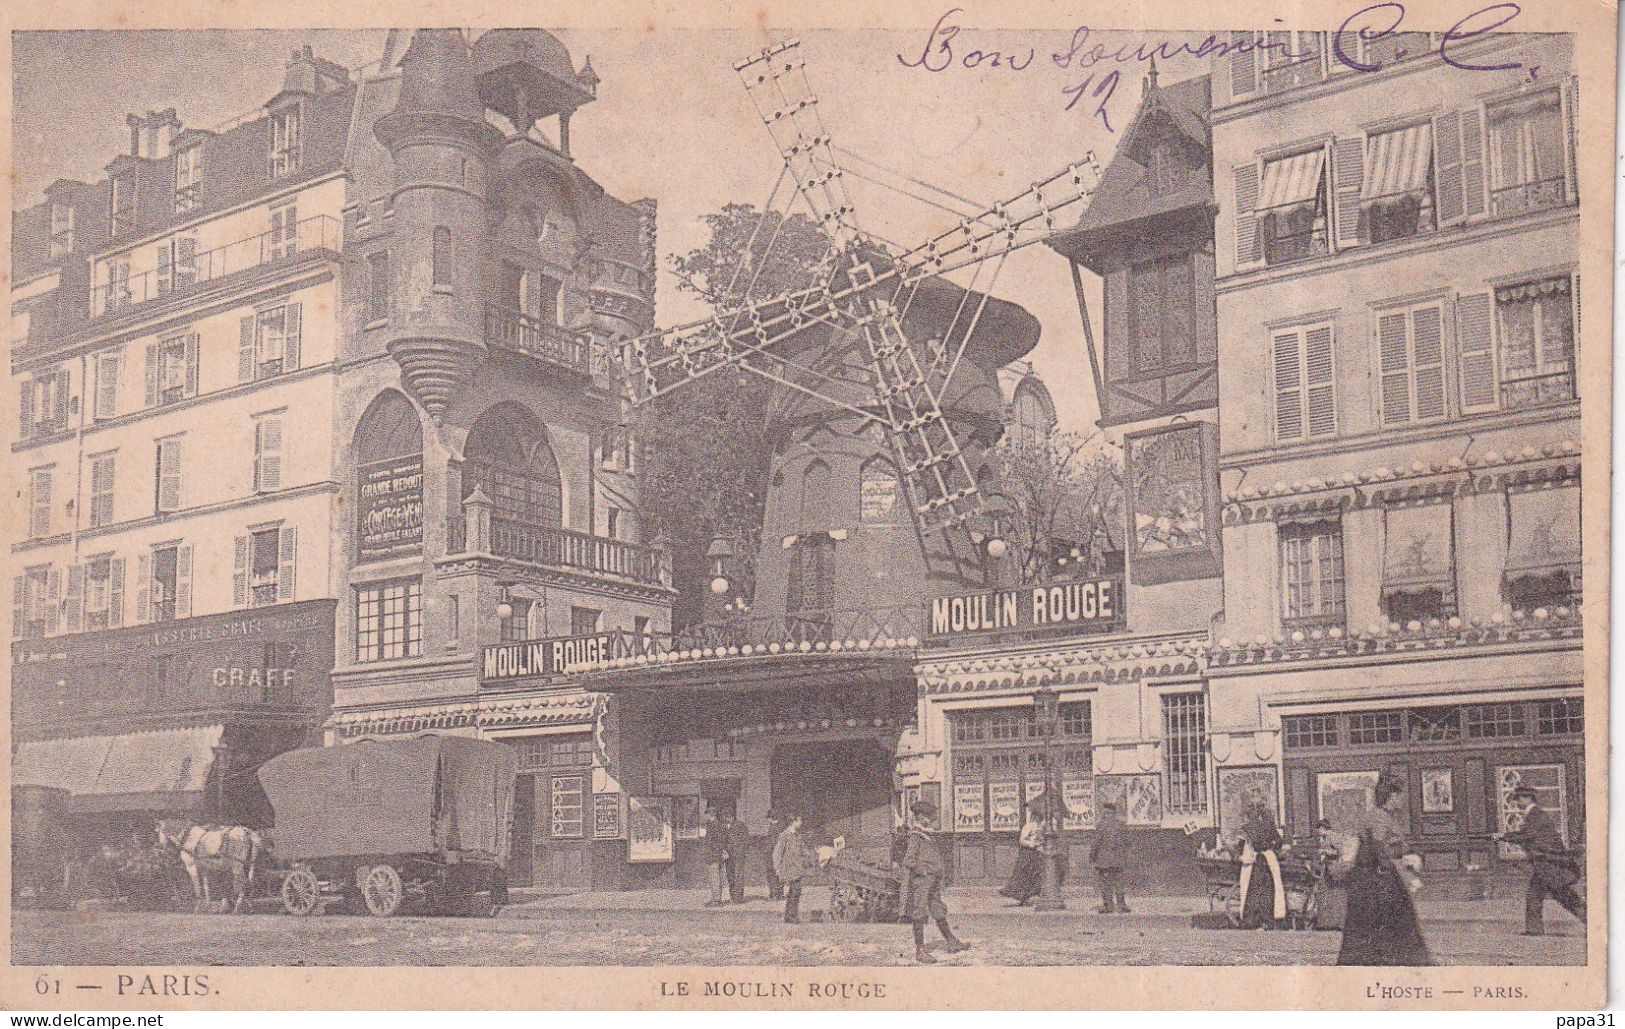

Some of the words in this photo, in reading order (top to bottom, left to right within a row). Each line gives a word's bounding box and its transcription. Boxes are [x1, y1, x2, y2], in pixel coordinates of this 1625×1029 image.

[898, 8, 1034, 72] Bon
[932, 592, 1017, 634] MOULIN
[1033, 581, 1112, 625] ROUGE
[484, 643, 544, 678] MOULIN
[553, 636, 608, 673] ROUGE
[212, 666, 295, 688] GRAFF
[35, 974, 60, 996] 61
[117, 974, 220, 996] PARIS.
[661, 982, 689, 996] LE
[704, 981, 794, 998] MOULIN
[808, 982, 887, 999] ROUGE
[1366, 982, 1433, 999] L'HOSTE
[1473, 986, 1529, 999] PARIS.
